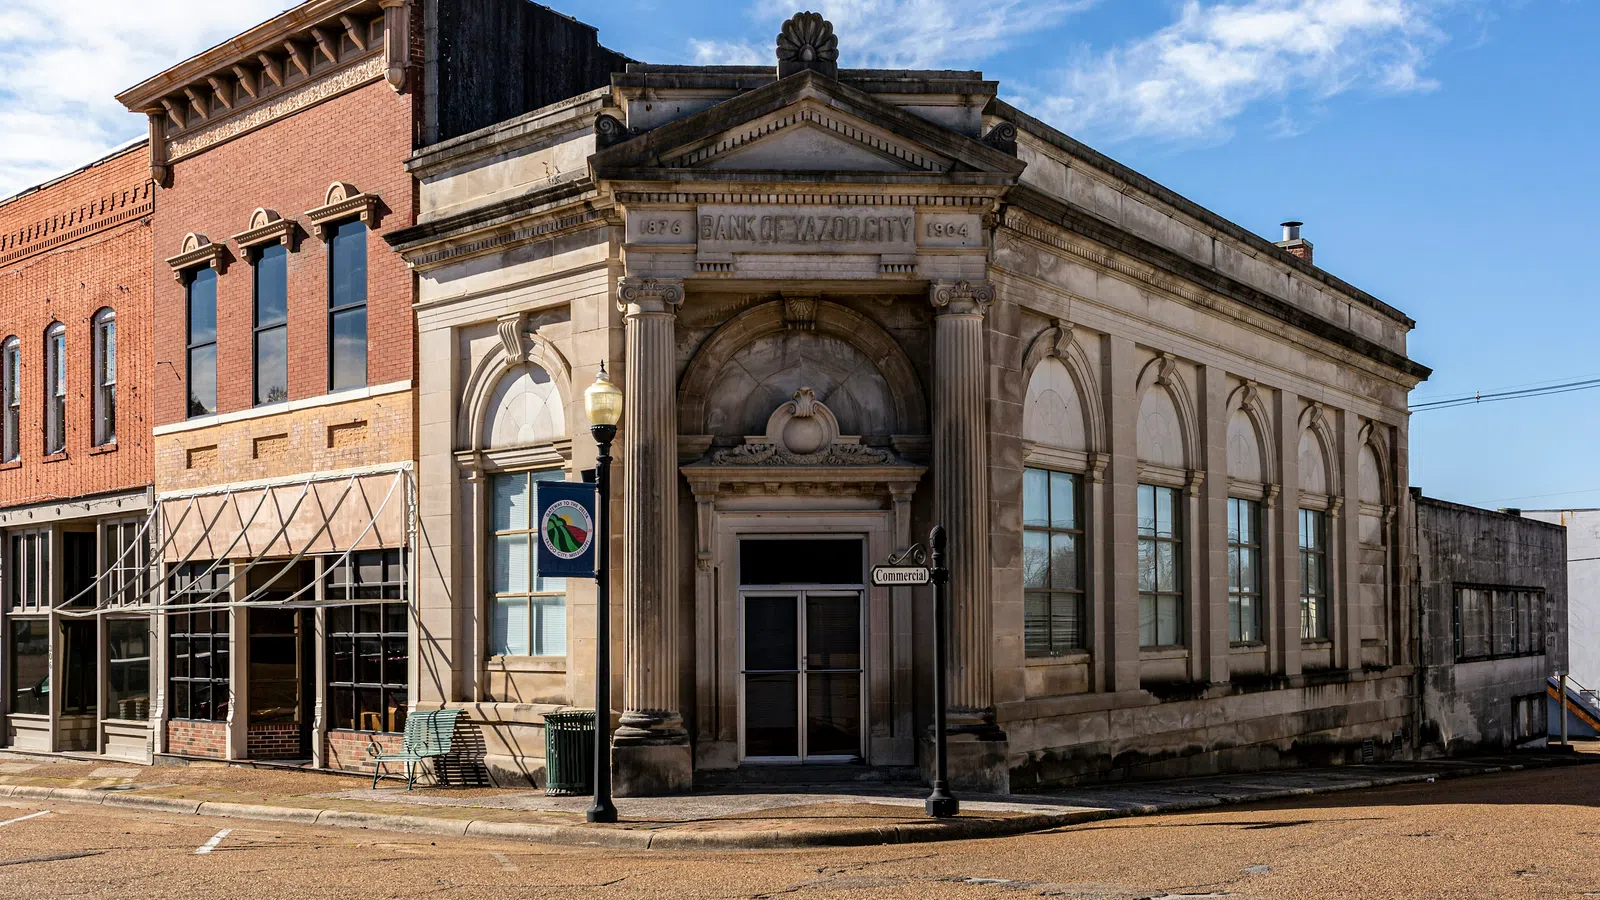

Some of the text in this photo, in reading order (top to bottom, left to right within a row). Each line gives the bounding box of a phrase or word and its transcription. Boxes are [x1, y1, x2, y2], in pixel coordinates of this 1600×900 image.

[641, 219, 682, 235] 1876
[700, 214, 912, 242] BANK OF YAZOO CITY
[927, 222, 969, 238] 1904
[546, 502, 562, 517] GATEWAY
[578, 506, 589, 519] DELTA
[545, 538, 556, 553] YAZOO
[876, 569, 926, 582] Commercial
